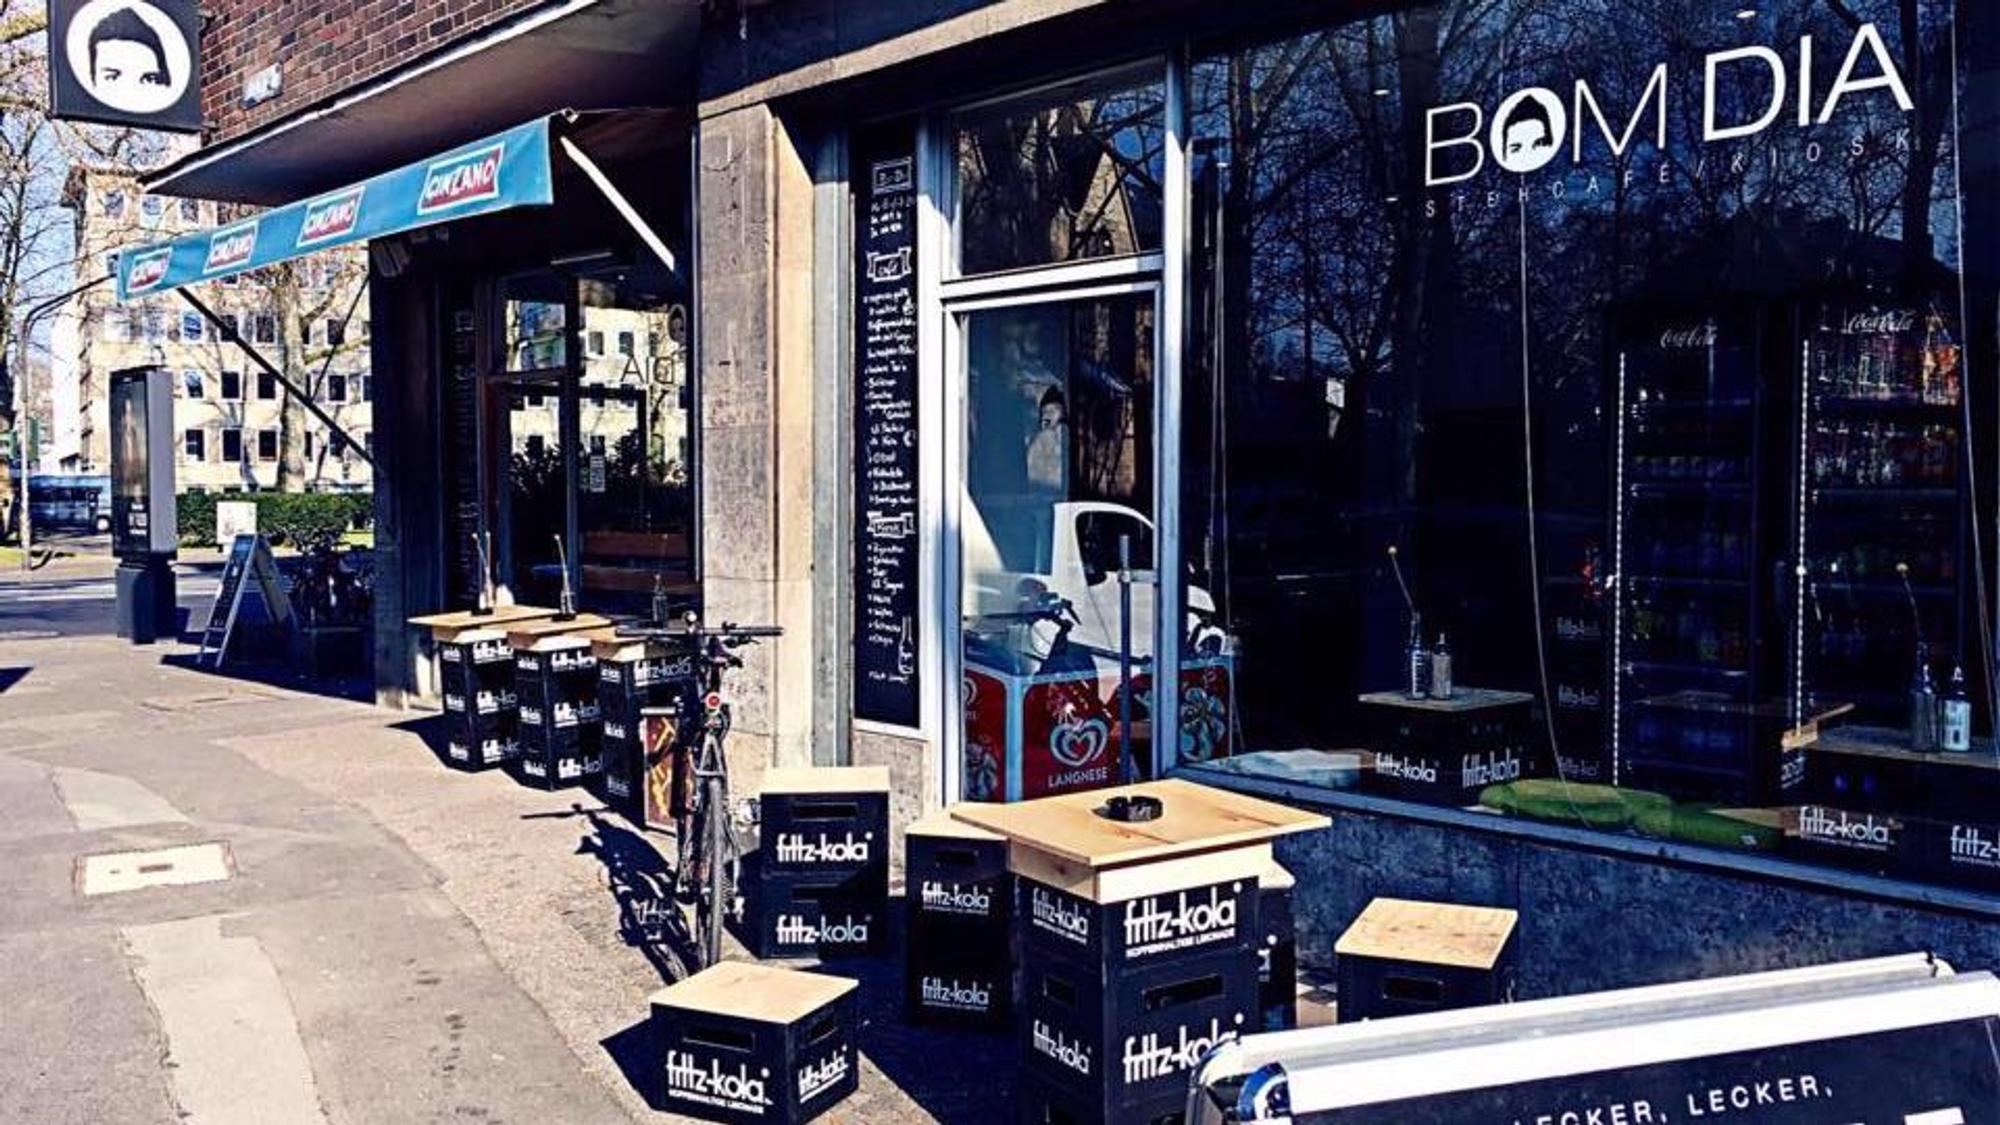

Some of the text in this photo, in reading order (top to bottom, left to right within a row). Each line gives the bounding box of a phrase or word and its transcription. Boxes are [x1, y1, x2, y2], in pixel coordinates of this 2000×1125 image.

[1703, 23, 1914, 141] DIA
[424, 159, 495, 200] CINZANO
[1048, 767, 1108, 788] LANGNESE
[1375, 752, 1437, 782] fritz-kola
[1463, 748, 1521, 789] fritz-kola
[1799, 806, 1889, 843] fritz-kola
[1950, 825, 2000, 860] fritz-
[776, 832, 868, 862] fritz-kola
[921, 881, 989, 908] fritz-kola
[1033, 887, 1089, 936] fritz-kola
[776, 914, 868, 944] fritz-kola
[1123, 886, 1236, 946] fritz-kola
[922, 976, 989, 1005] fritz-kola
[1033, 1019, 1089, 1074] fritz-kola
[666, 1050, 764, 1104] fritz-kola
[1687, 1074, 1833, 1117] LECKER,
